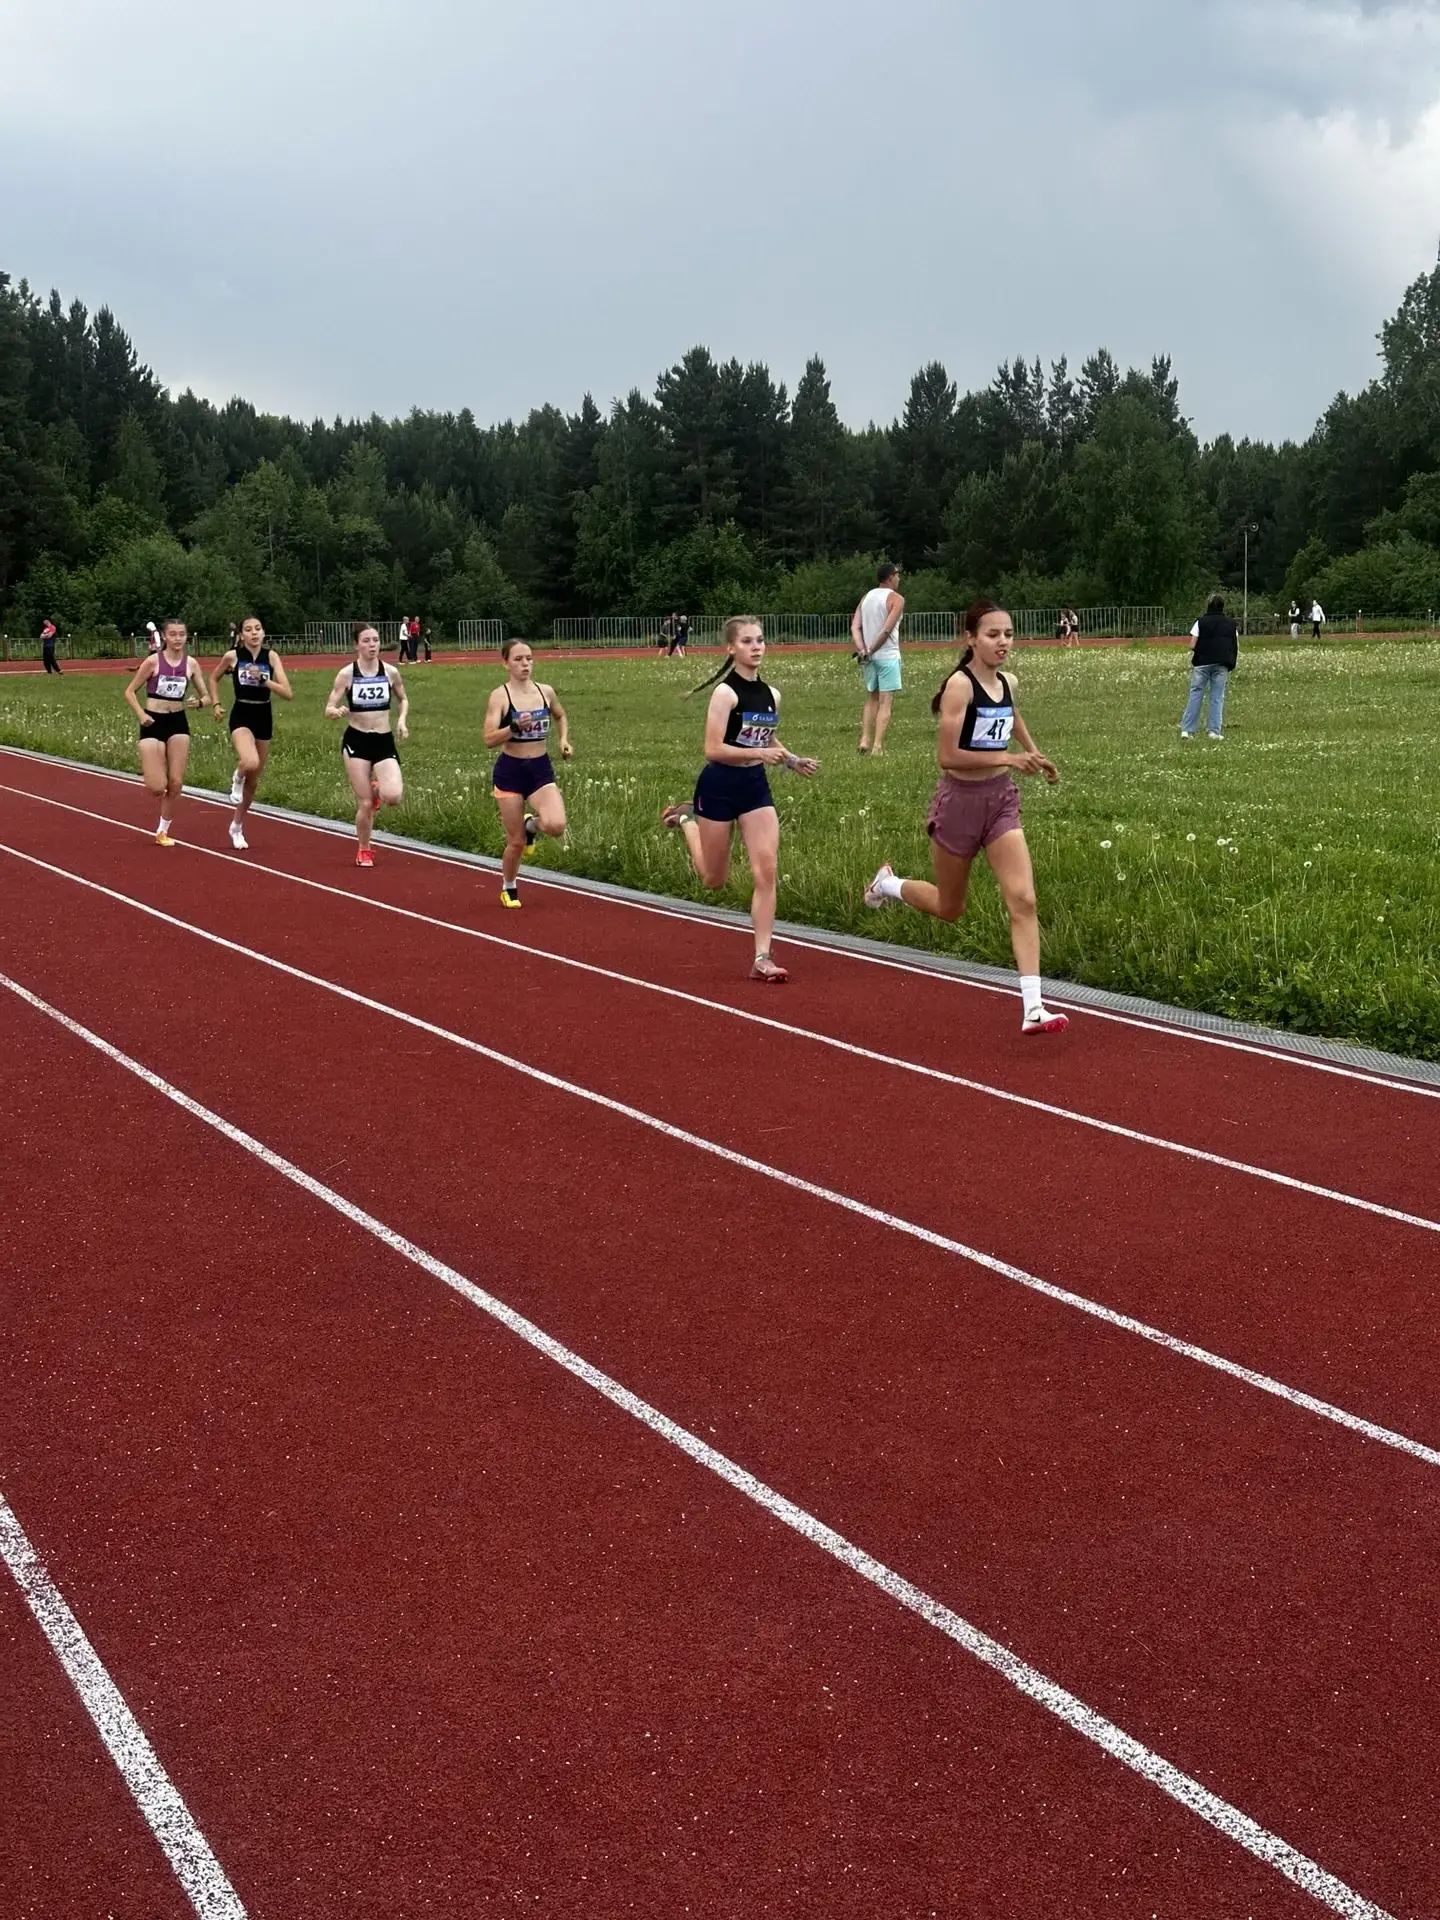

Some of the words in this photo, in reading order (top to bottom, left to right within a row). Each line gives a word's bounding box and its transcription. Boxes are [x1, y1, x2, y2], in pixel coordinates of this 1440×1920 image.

[167, 684, 178, 692] 87
[358, 687, 384, 700] 432
[987, 719, 1006, 740] 47
